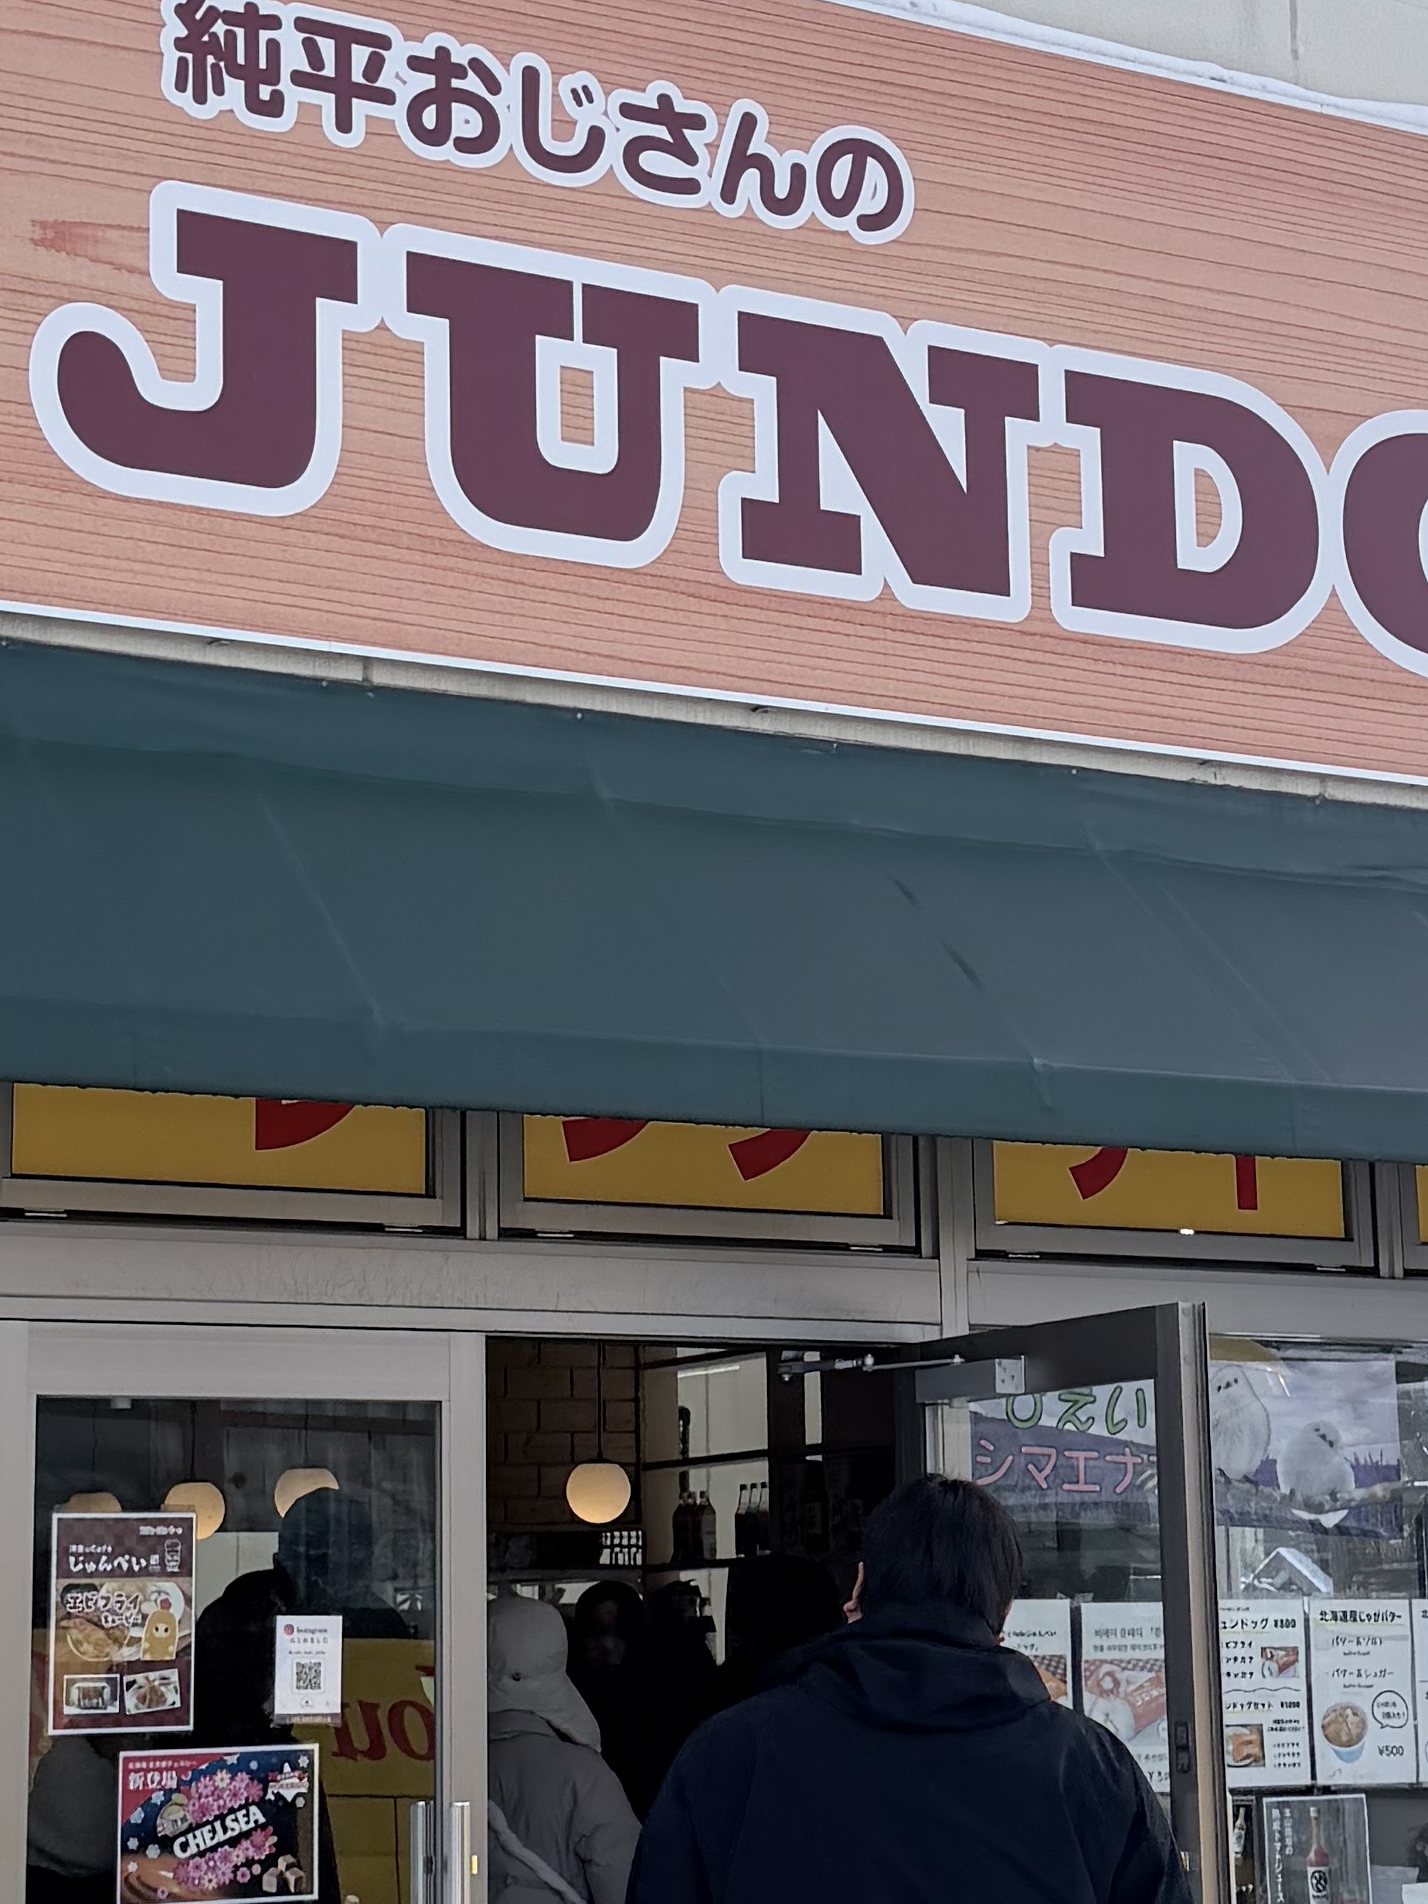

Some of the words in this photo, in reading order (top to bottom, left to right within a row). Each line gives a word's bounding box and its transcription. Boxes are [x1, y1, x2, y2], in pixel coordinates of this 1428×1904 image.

[975, 1439, 1157, 1495] シマエナ
[1376, 1745, 1405, 1757] ¥500
[172, 1804, 267, 1860] CHELSEA
